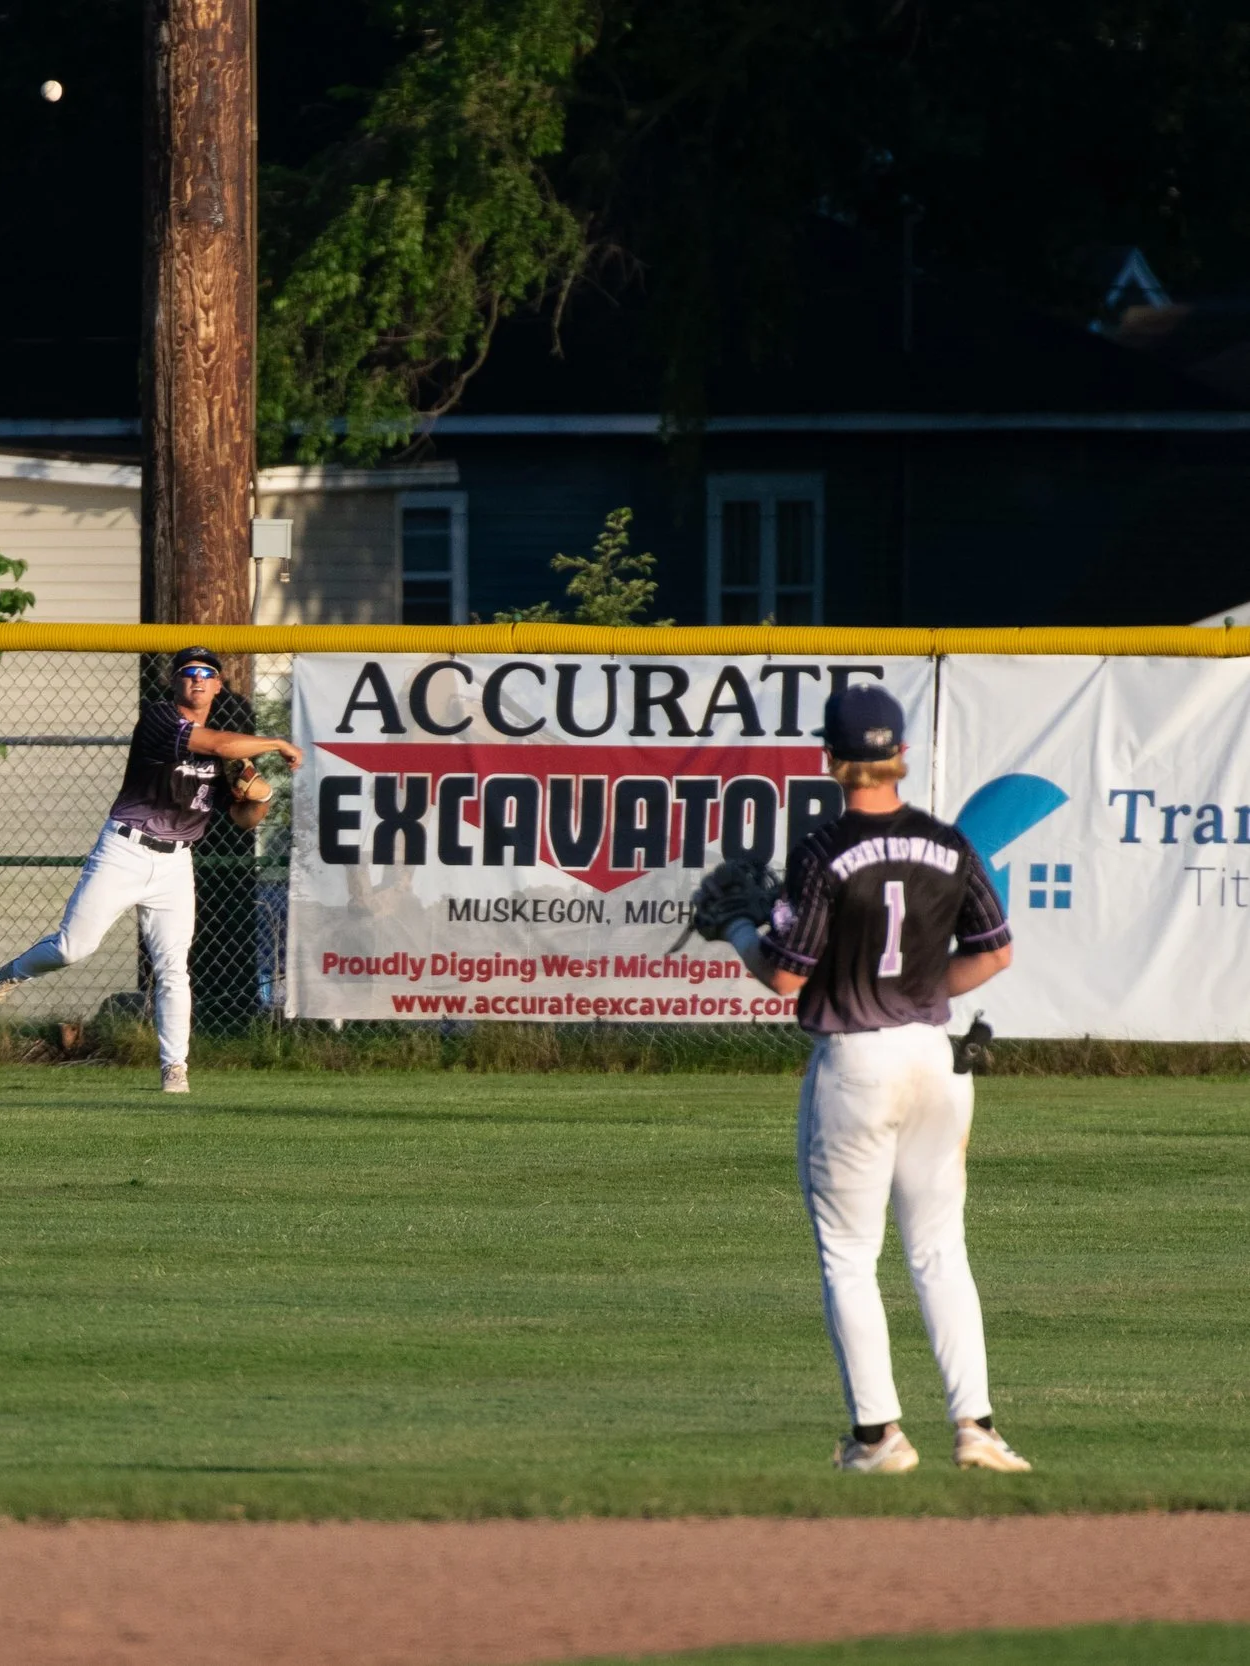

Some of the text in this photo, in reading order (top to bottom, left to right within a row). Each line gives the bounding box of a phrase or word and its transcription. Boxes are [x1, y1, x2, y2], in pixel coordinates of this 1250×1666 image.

[318, 774, 846, 870] EXCAVATOR
[830, 836, 960, 881] TERRY HOWARD
[448, 897, 612, 925] MUSKEGON,
[877, 880, 906, 978] 1
[322, 951, 741, 984] Proudly Digging West Michigan
